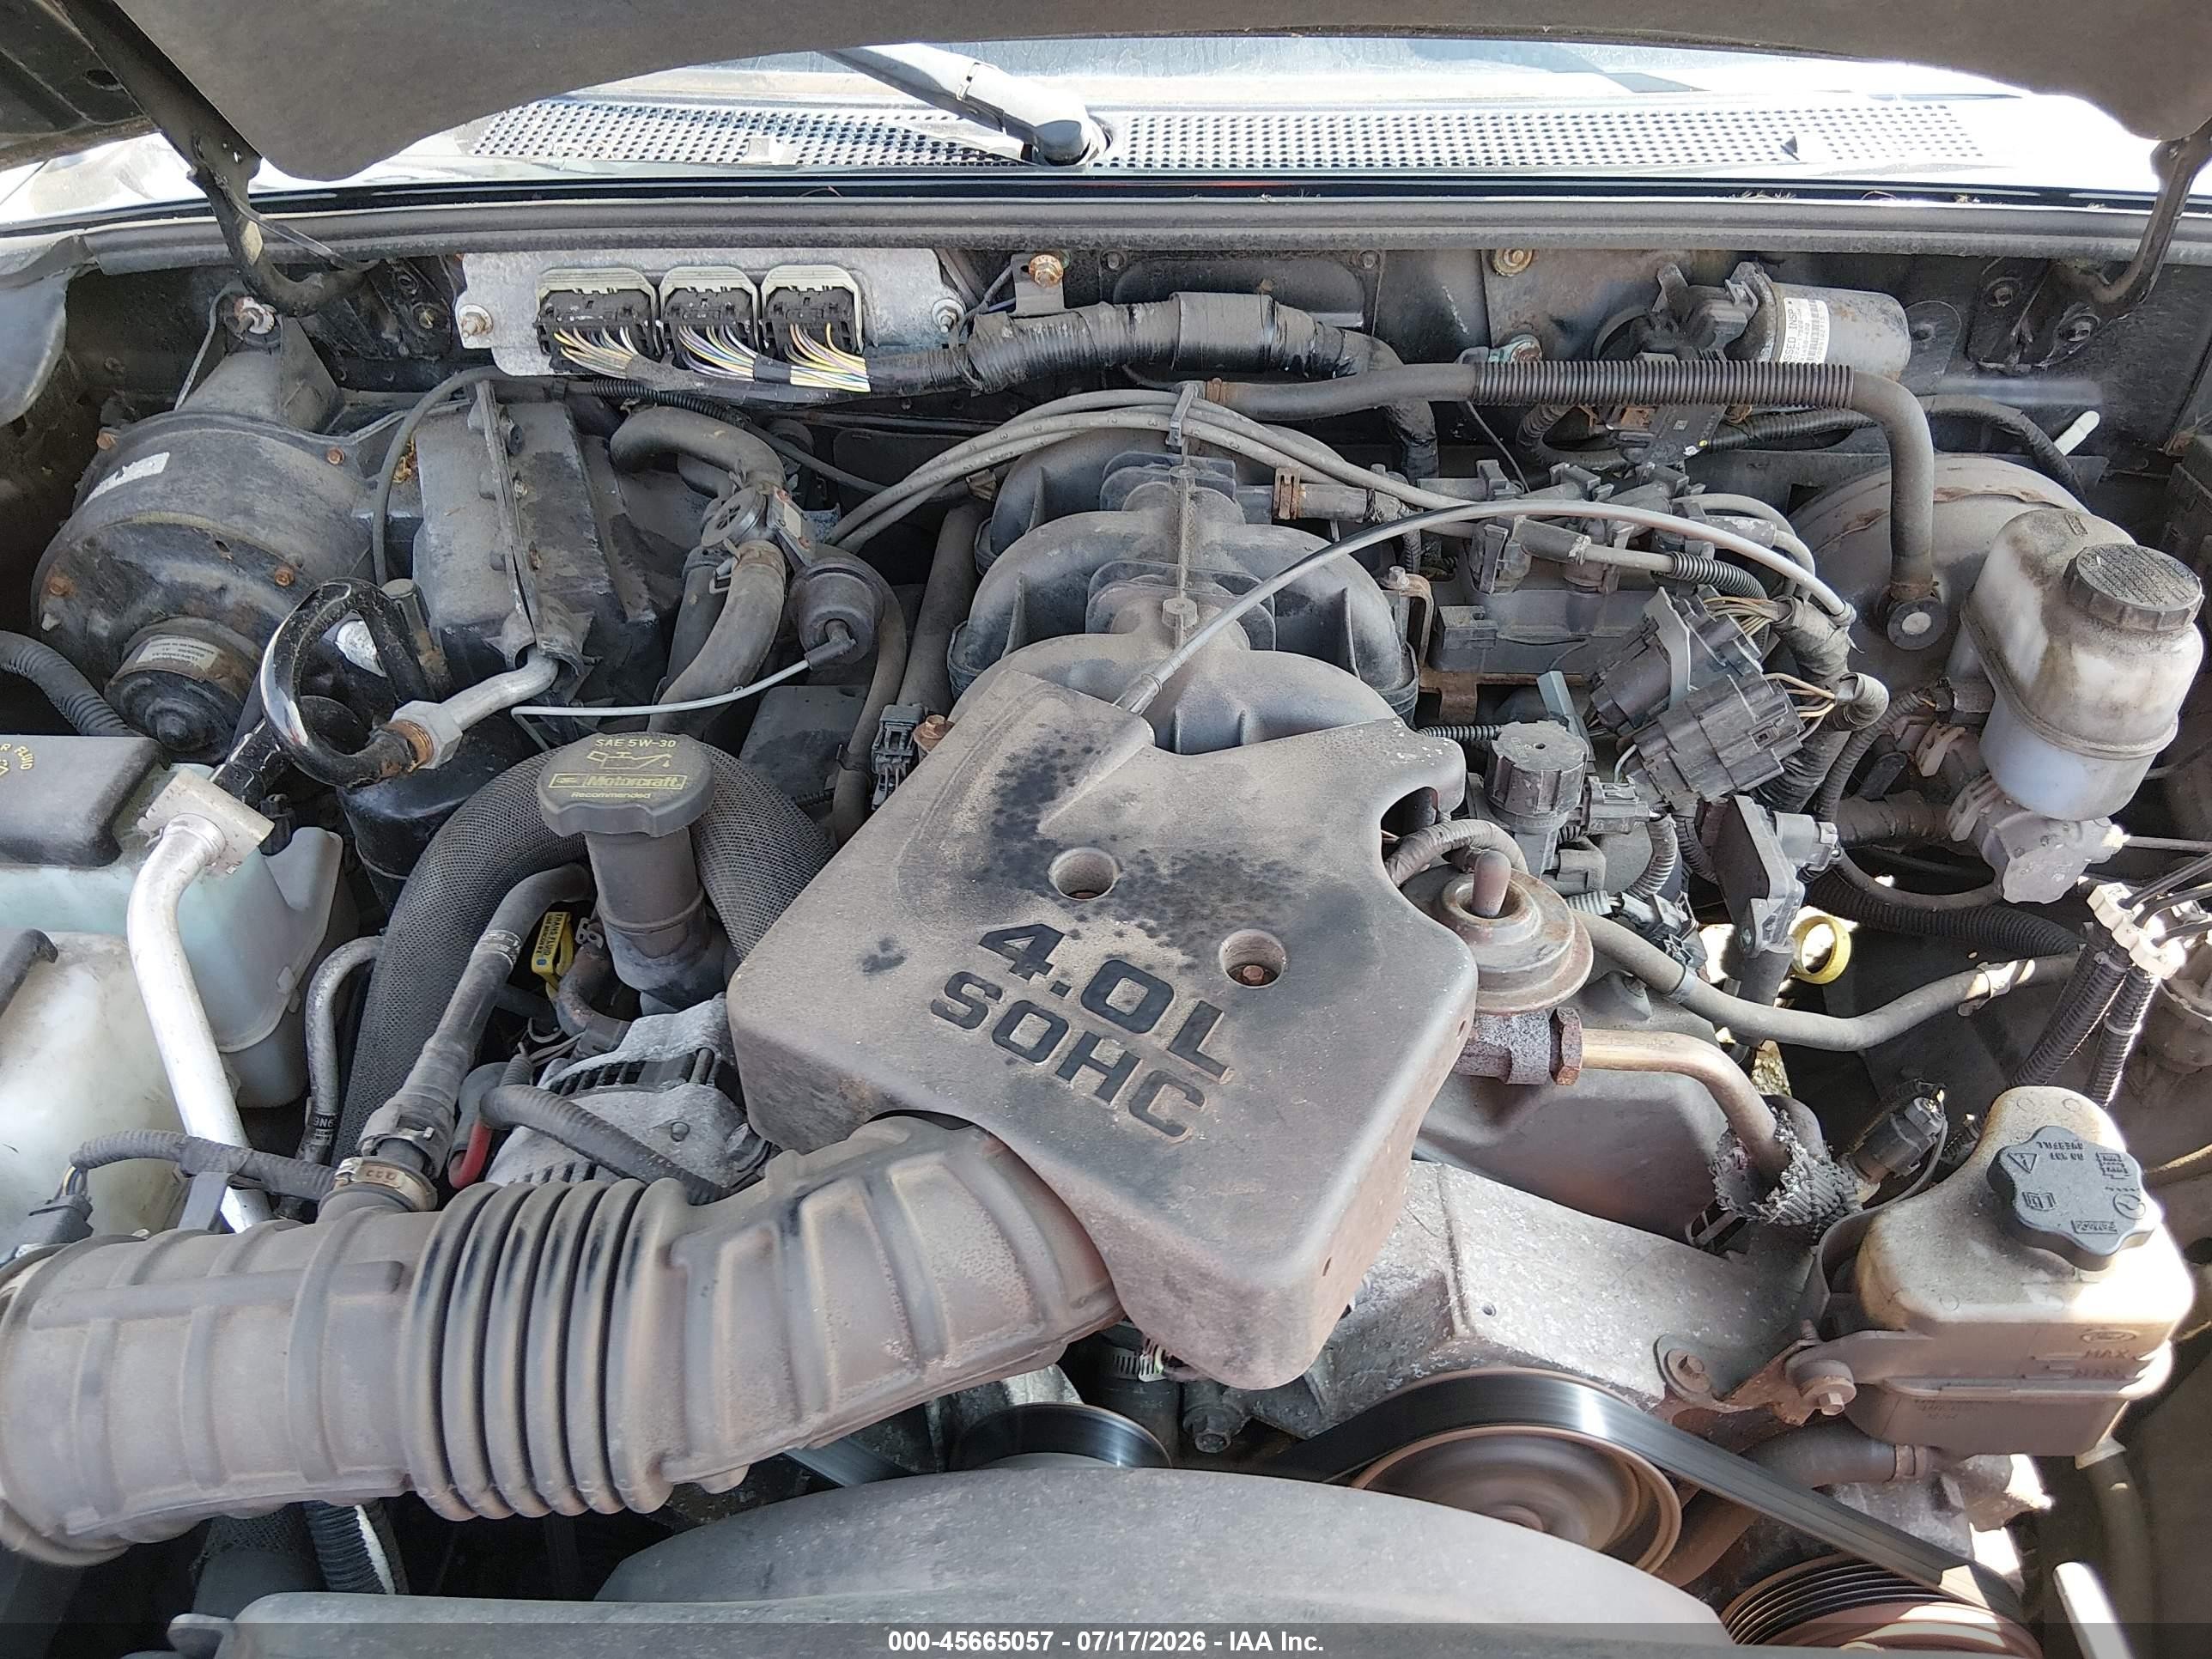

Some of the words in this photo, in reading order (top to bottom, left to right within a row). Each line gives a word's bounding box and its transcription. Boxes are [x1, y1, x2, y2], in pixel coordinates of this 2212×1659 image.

[1784, 336, 1796, 362] SSED
[594, 738, 624, 748] SAE
[627, 738, 678, 749] 5W-30
[586, 775, 680, 788] Motorcraft
[570, 791, 653, 799] Recommended
[978, 922, 1235, 1085] 4.0L
[930, 970, 1207, 1142] SOHC
